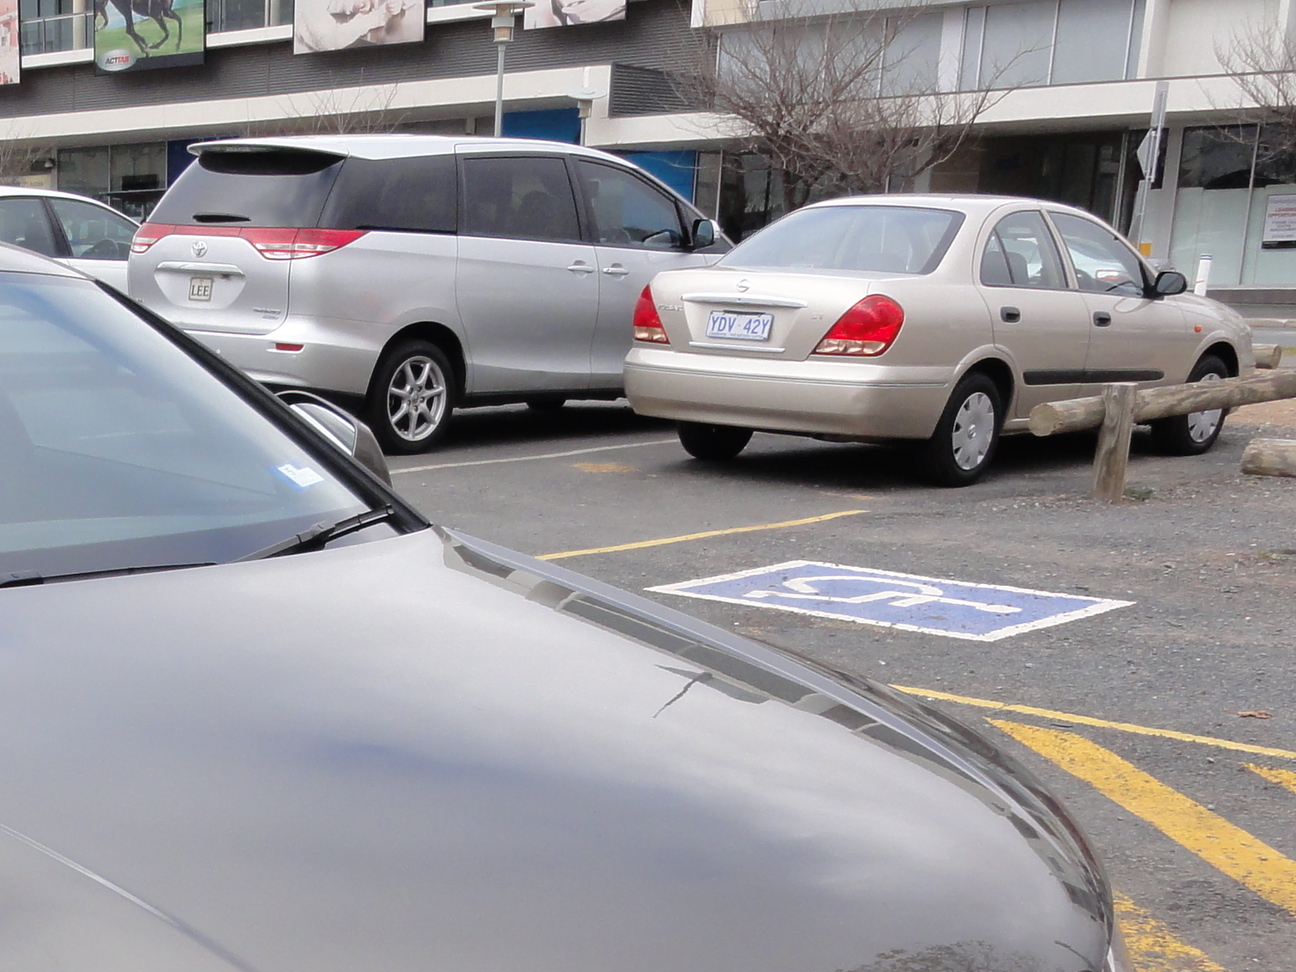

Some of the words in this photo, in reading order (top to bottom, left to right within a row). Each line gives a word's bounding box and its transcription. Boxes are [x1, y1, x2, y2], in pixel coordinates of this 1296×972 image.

[191, 284, 209, 297] LEE
[711, 315, 737, 333] YDV
[743, 318, 770, 335] 42Y
